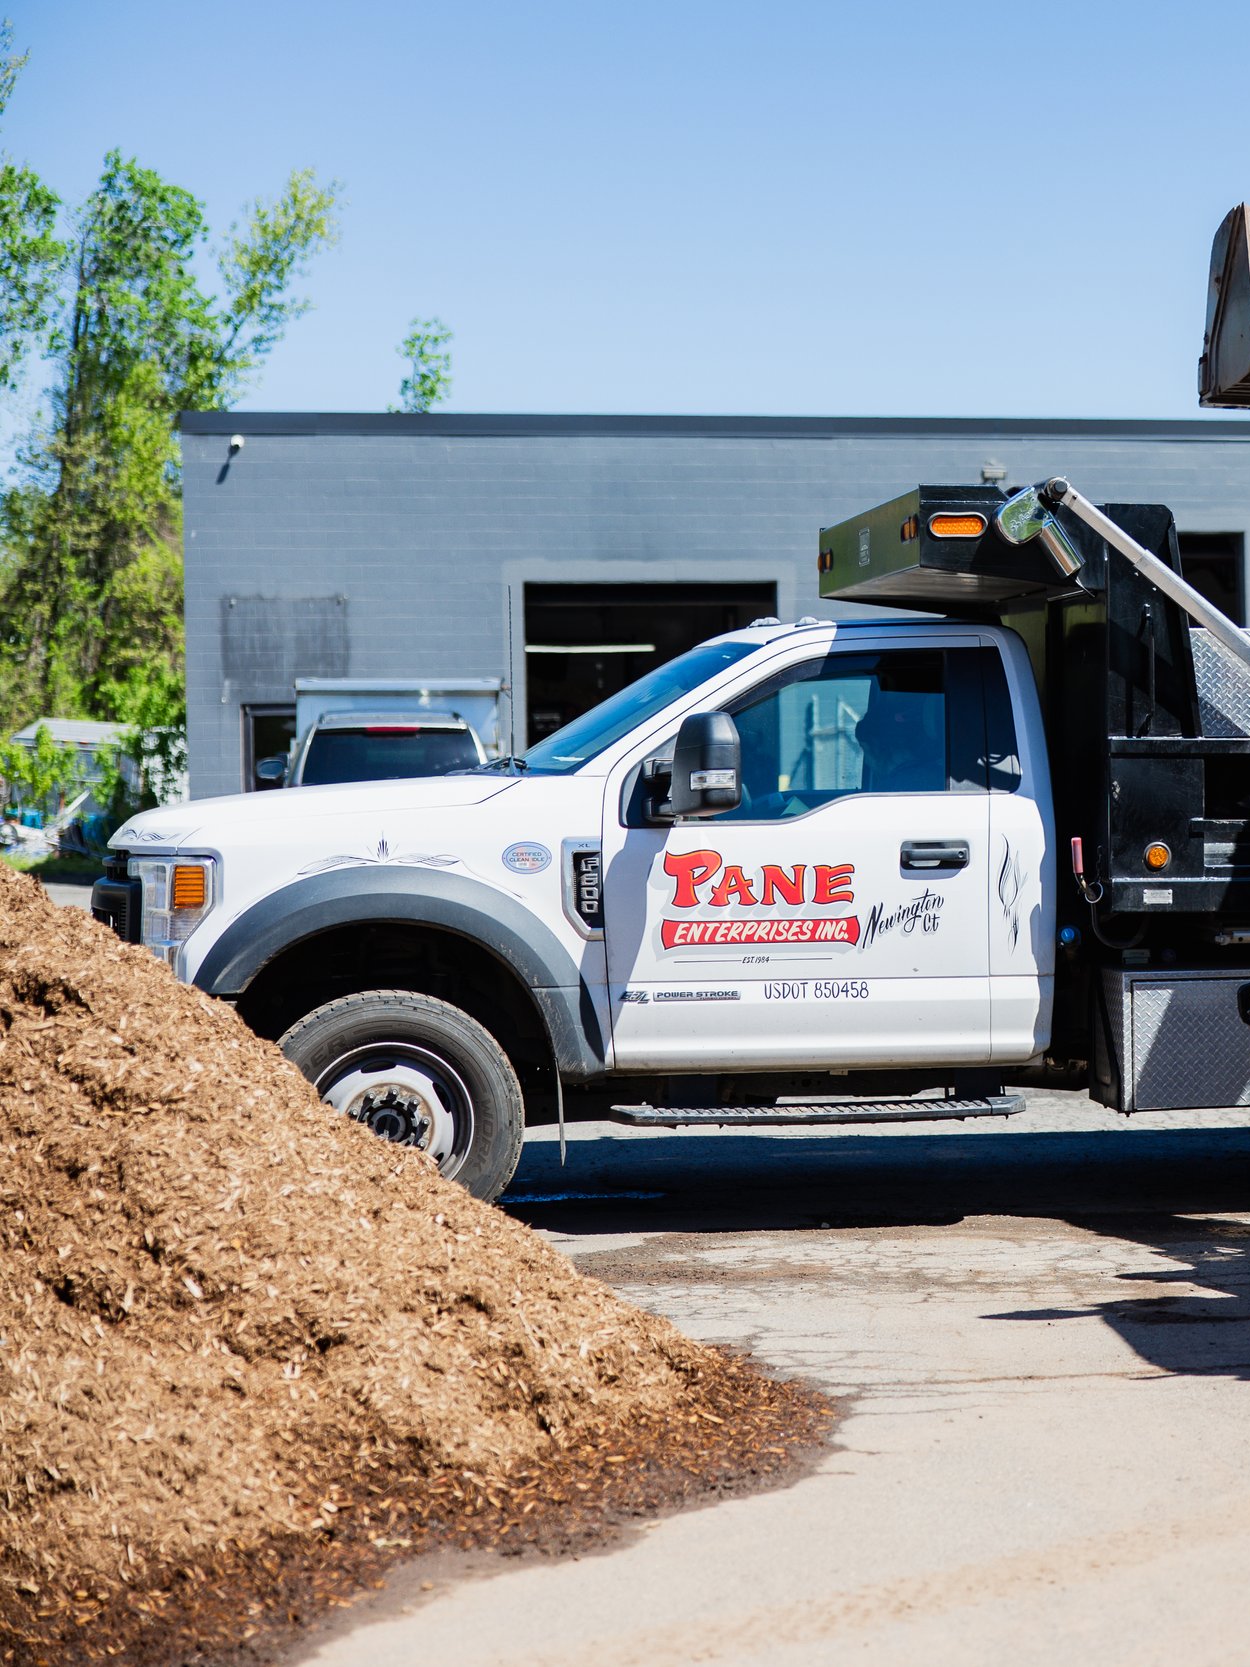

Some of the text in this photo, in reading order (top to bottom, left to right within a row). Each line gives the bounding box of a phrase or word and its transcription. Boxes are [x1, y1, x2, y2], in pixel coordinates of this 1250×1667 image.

[580, 857, 600, 914] F600
[663, 849, 855, 908] PANE
[673, 920, 850, 944] ENTERPRISES INC.
[862, 888, 945, 949] Newington
[656, 991, 694, 999] POWER
[694, 990, 739, 998] STROKE
[764, 981, 870, 1000] USDOT 850458
